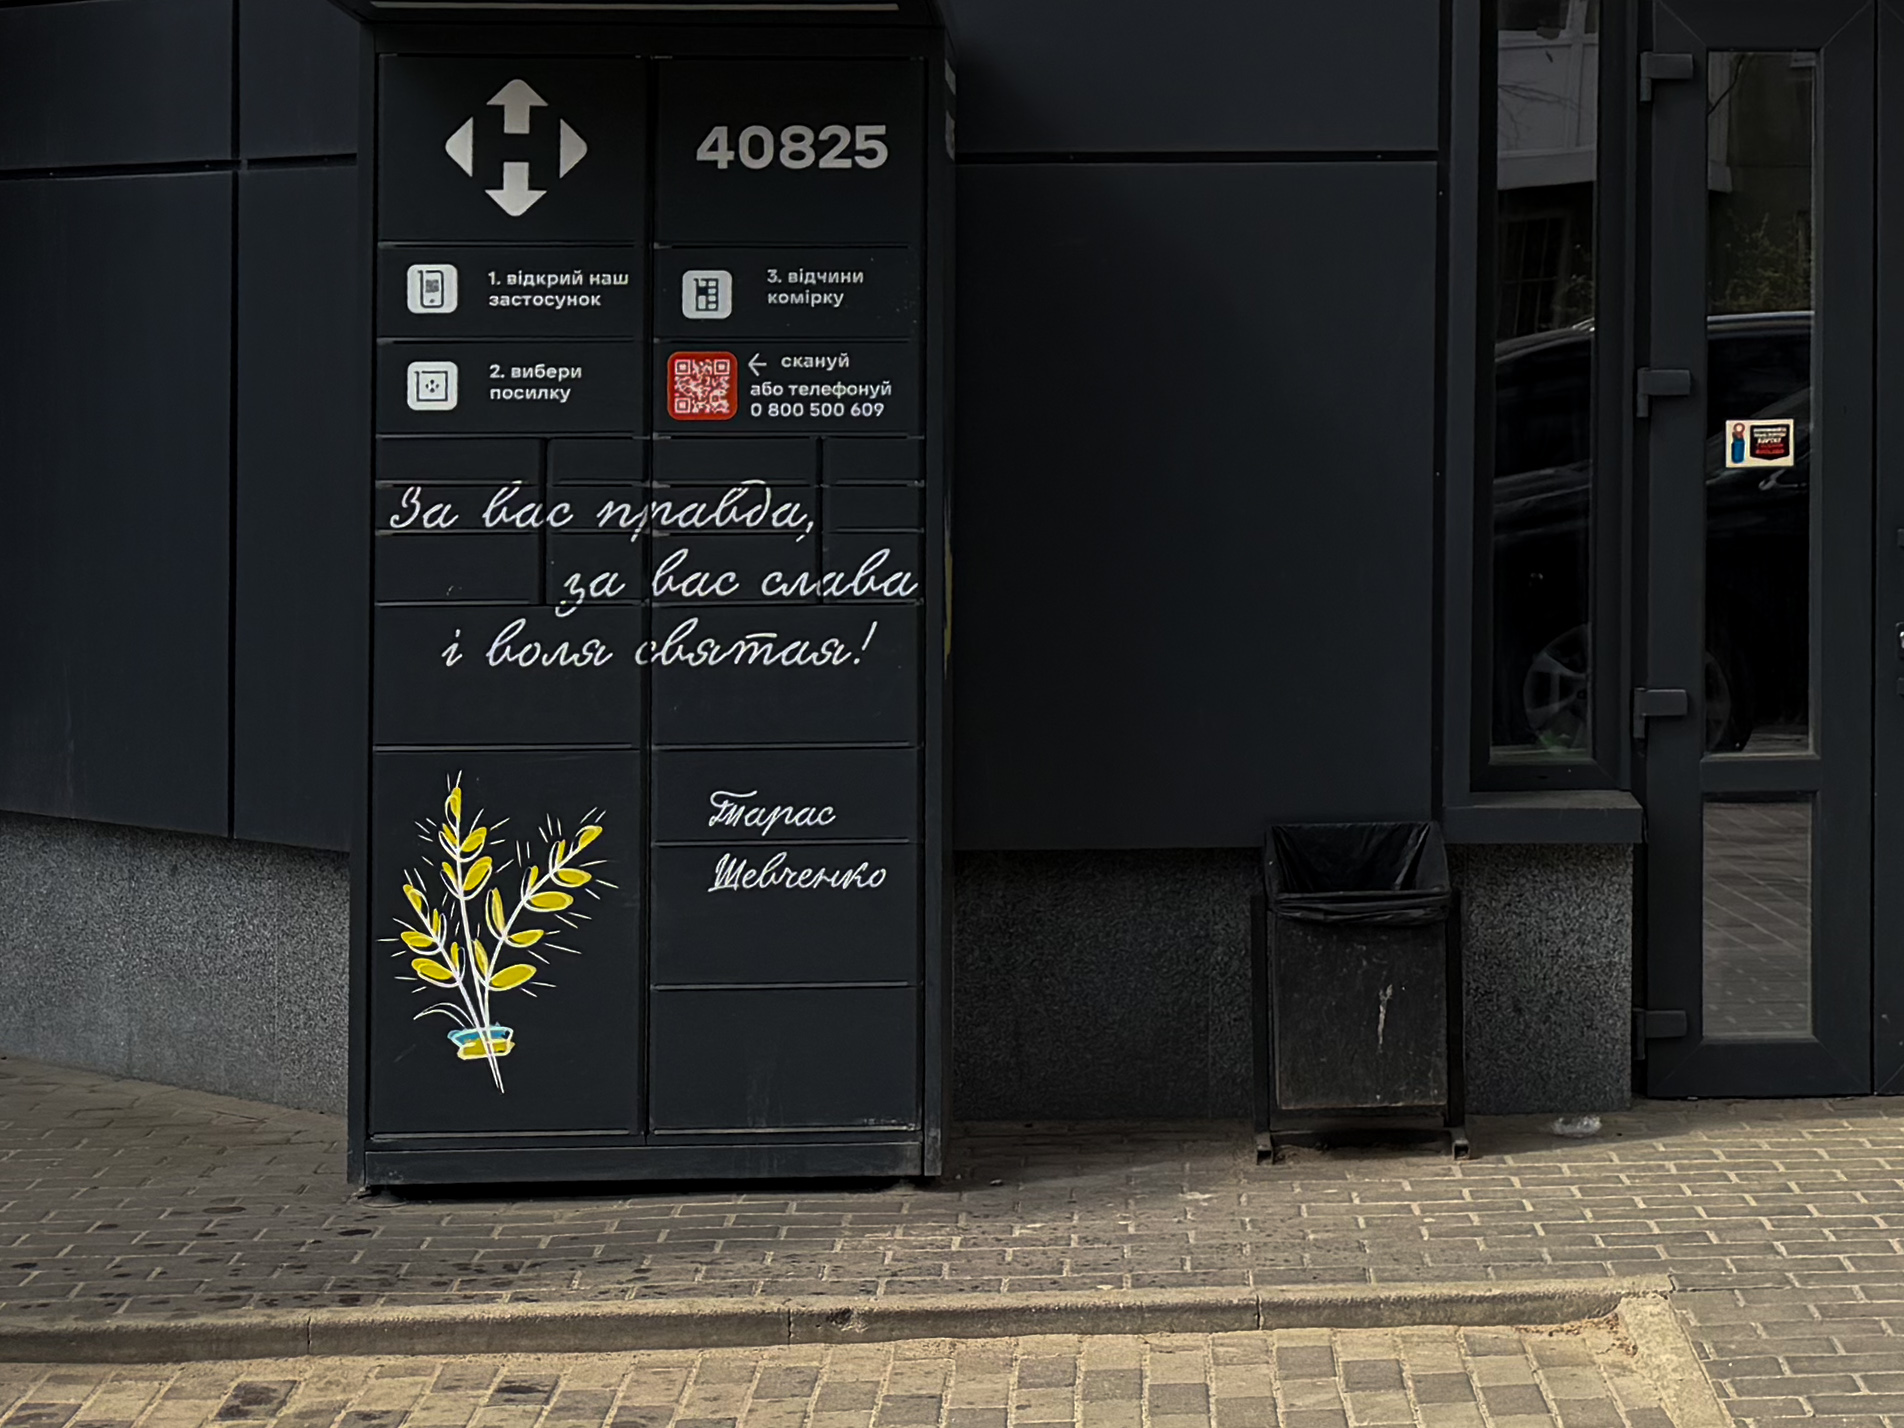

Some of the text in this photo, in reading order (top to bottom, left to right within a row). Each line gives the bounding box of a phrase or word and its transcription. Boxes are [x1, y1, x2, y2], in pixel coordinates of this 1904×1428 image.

[695, 124, 889, 169] 40825
[487, 270, 630, 289] 1. відкрий наш
[766, 268, 865, 285] 3. відчини
[488, 294, 602, 310] застосунок
[767, 289, 844, 307] комірку
[780, 352, 850, 371] скануй
[489, 363, 582, 382] 2. вибери
[489, 387, 571, 403] посилку
[750, 381, 892, 399] або телефонуй
[750, 402, 885, 417] 0 800 500 609
[389, 479, 814, 542] За вас правда,
[554, 546, 919, 617] за вас слава
[440, 617, 878, 667] і воля святая!
[708, 789, 837, 837] Тарас
[707, 851, 888, 893] Шевченко
